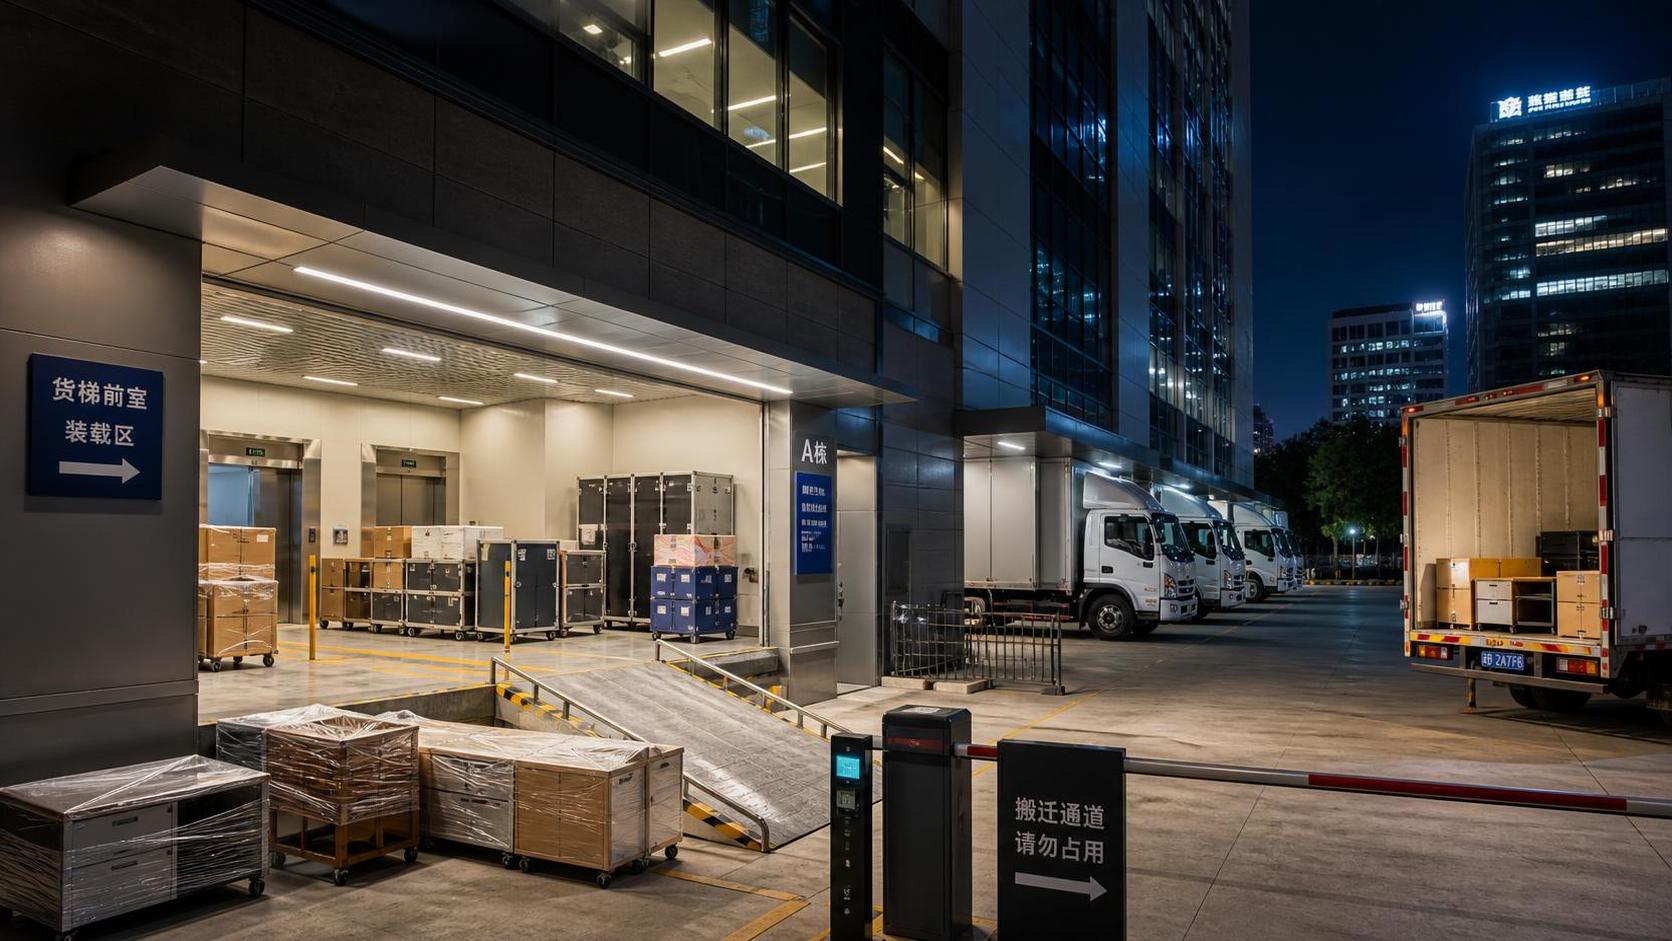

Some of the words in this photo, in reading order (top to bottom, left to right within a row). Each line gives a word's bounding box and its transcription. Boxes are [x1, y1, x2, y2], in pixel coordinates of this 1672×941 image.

[52, 376, 148, 410] 货梯前室
[65, 419, 135, 447] 装载区
[1015, 796, 1105, 830] 搬迁通道
[1015, 831, 1104, 865] 请勿占用
